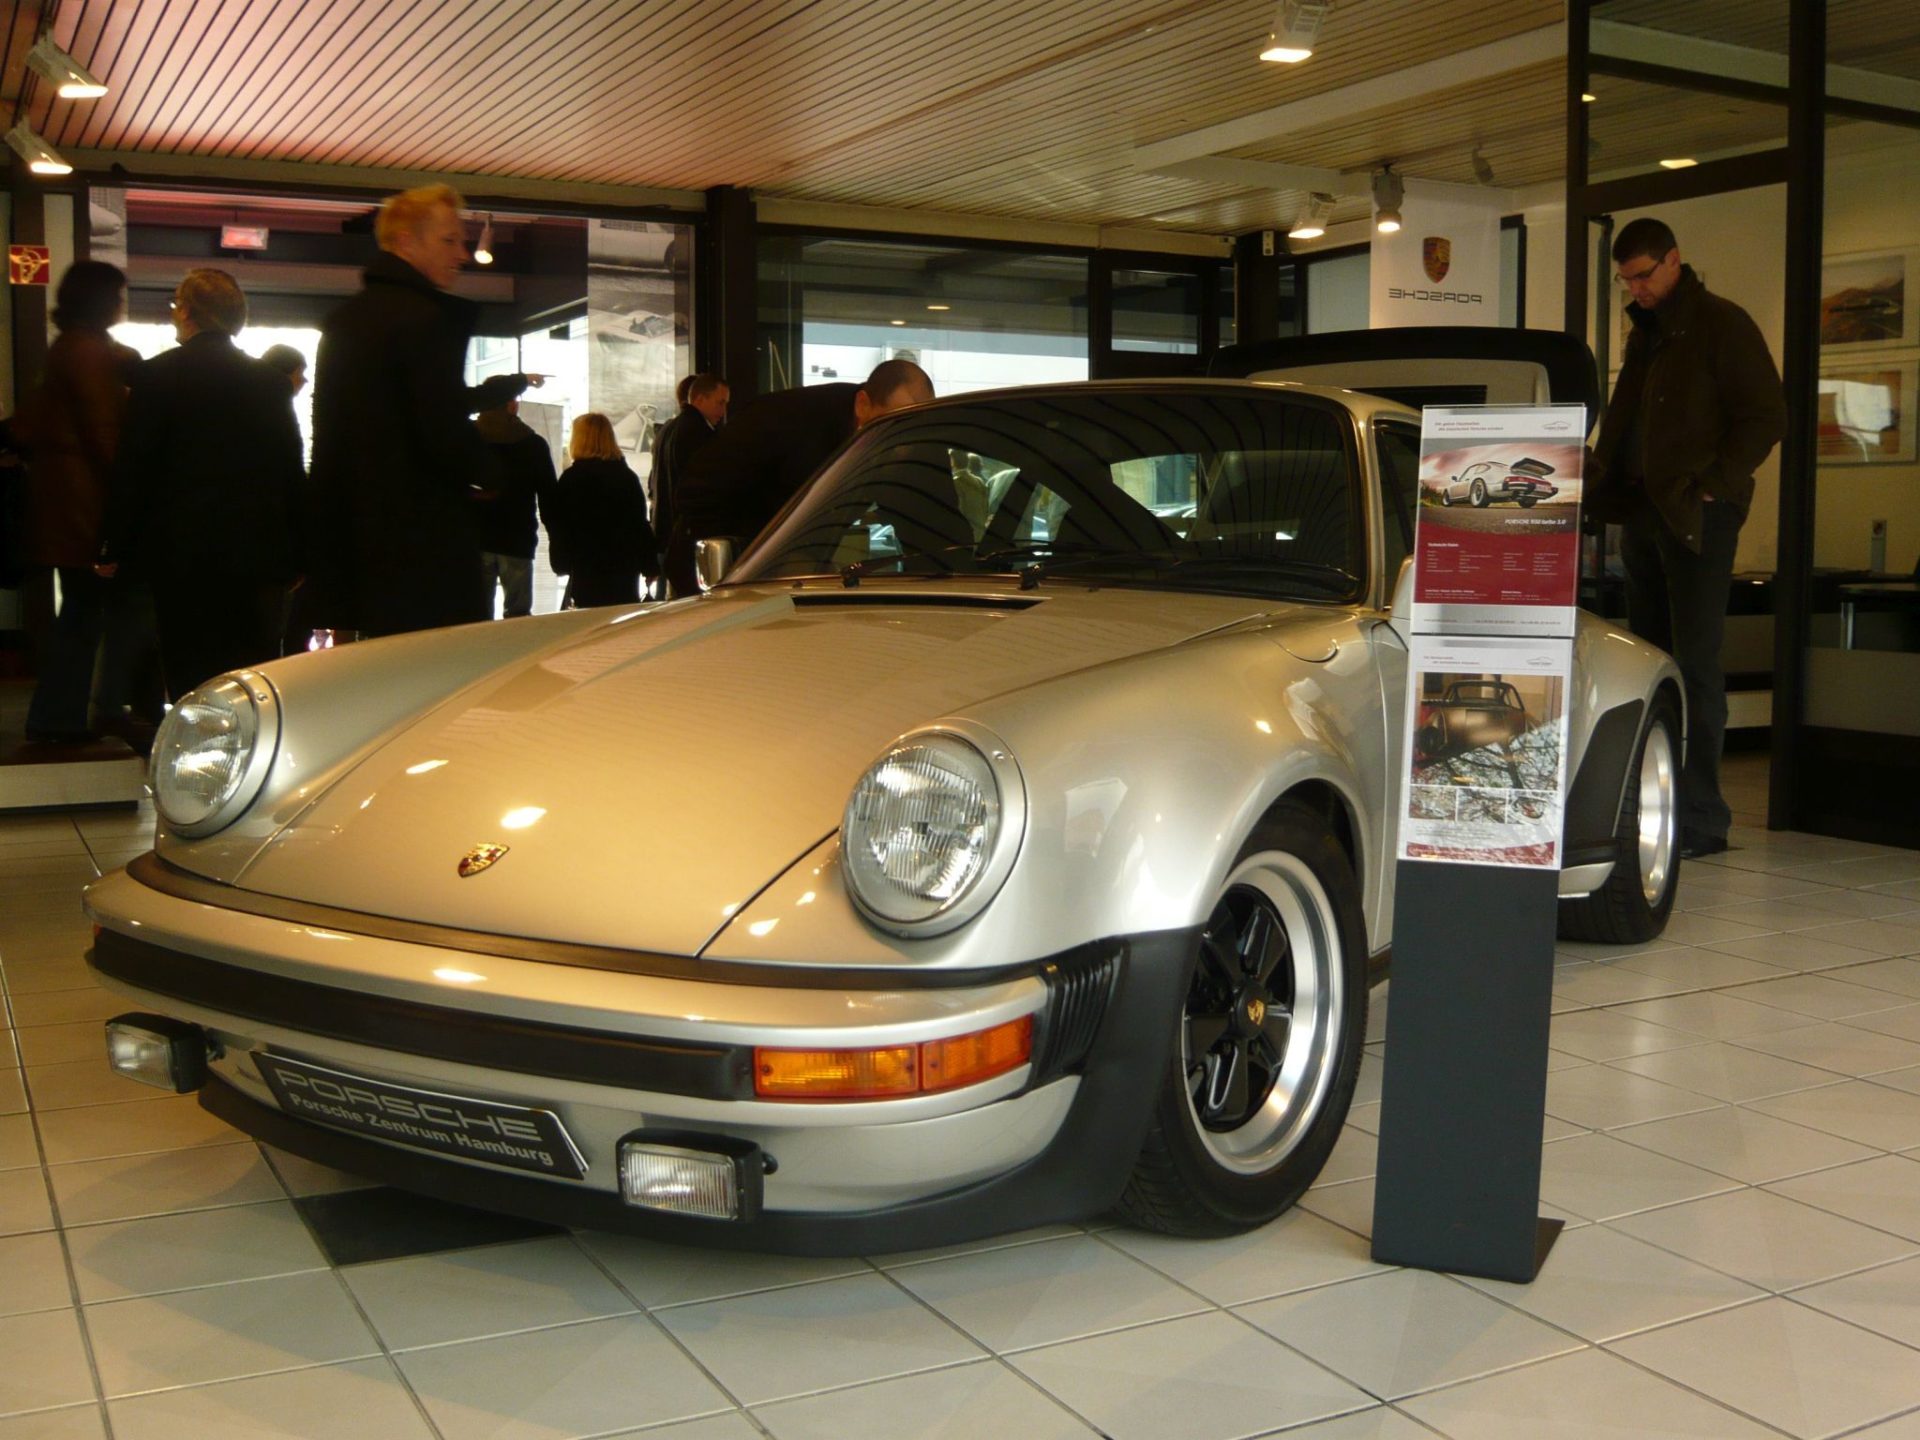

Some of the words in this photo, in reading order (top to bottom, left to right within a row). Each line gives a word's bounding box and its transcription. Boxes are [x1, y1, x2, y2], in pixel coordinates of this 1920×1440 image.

[274, 1068, 542, 1142] PORSCHE
[290, 1093, 363, 1122] Porsche
[366, 1112, 451, 1143] Zentrum
[454, 1132, 554, 1166] Hamburg
